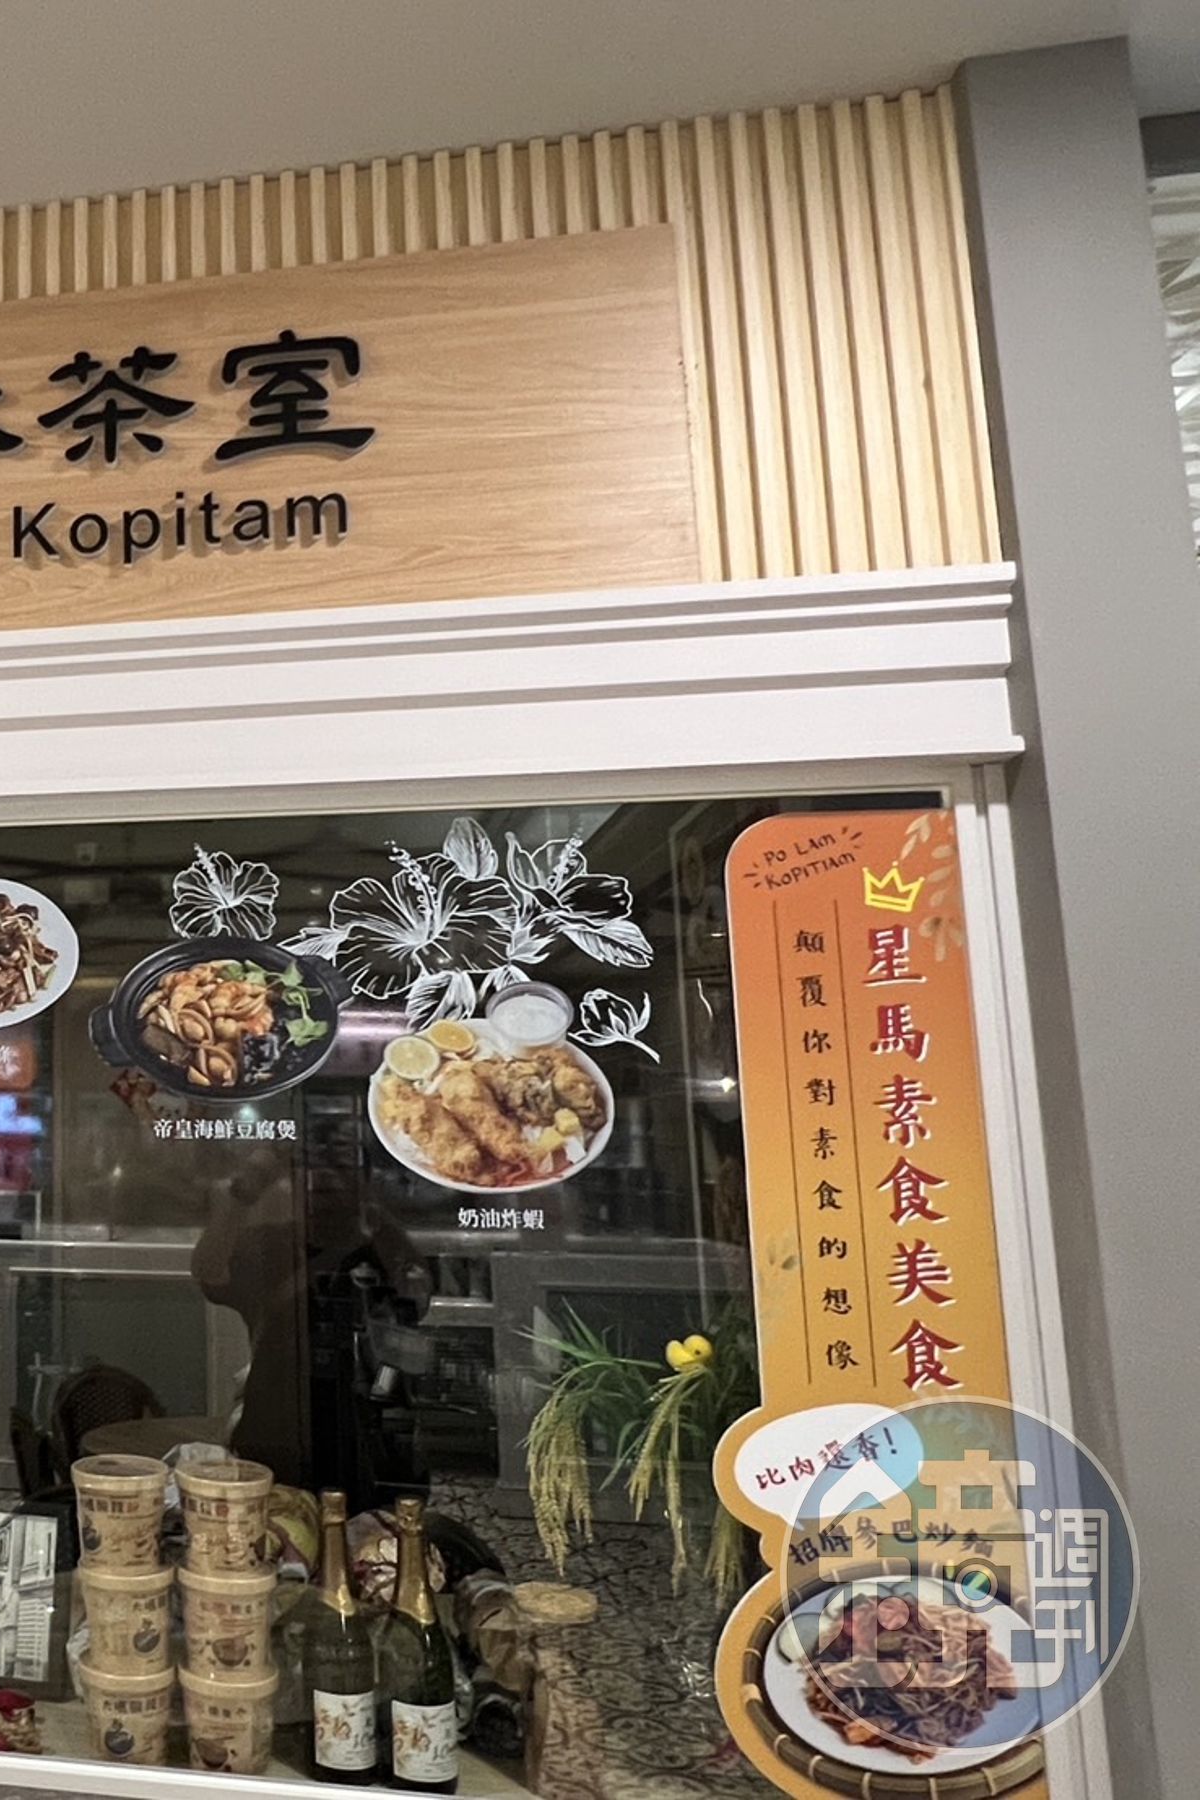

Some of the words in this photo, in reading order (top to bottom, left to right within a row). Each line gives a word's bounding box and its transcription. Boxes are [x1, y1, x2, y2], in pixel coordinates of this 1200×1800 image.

[13, 486, 351, 566] Kopitam
[153, 1117, 297, 1142] 帝皇海鮮豆腐煲
[793, 929, 860, 1370] 顛覆你對素食的想像
[862, 925, 965, 1391] 星馬素食美食
[457, 1207, 545, 1231] 奶油炸蝦
[754, 1426, 898, 1491] 比肉還香!
